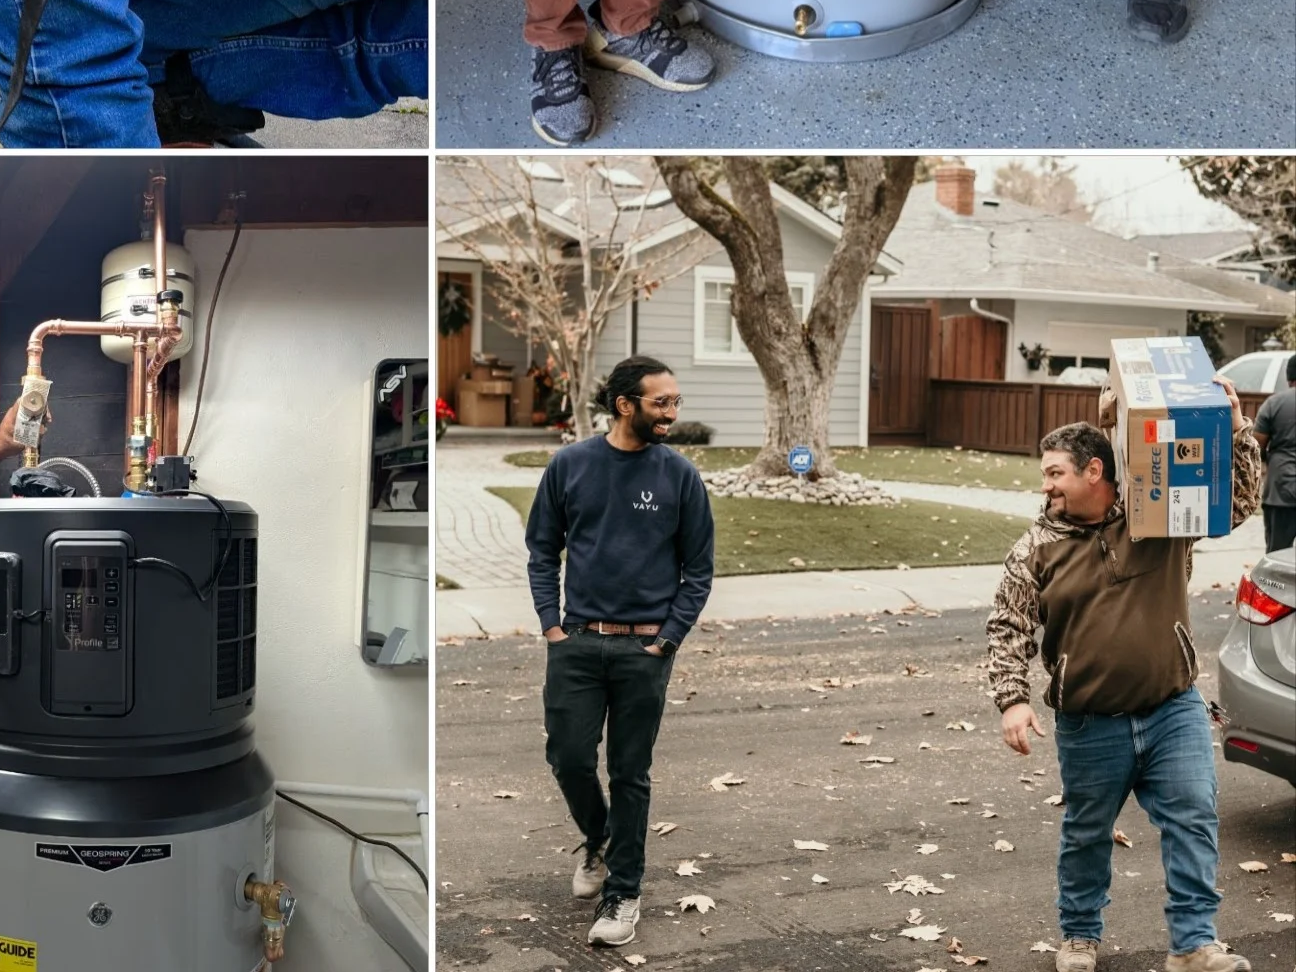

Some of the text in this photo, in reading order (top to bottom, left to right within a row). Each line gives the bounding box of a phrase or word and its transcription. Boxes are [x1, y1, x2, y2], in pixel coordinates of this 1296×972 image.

[1151, 446, 1162, 486] GREE
[1173, 489, 1181, 505] 243
[633, 502, 659, 511] VAYU
[74, 638, 103, 647] Profile
[39, 848, 70, 856] PREMIUM
[80, 849, 130, 859] GEOSPRING
